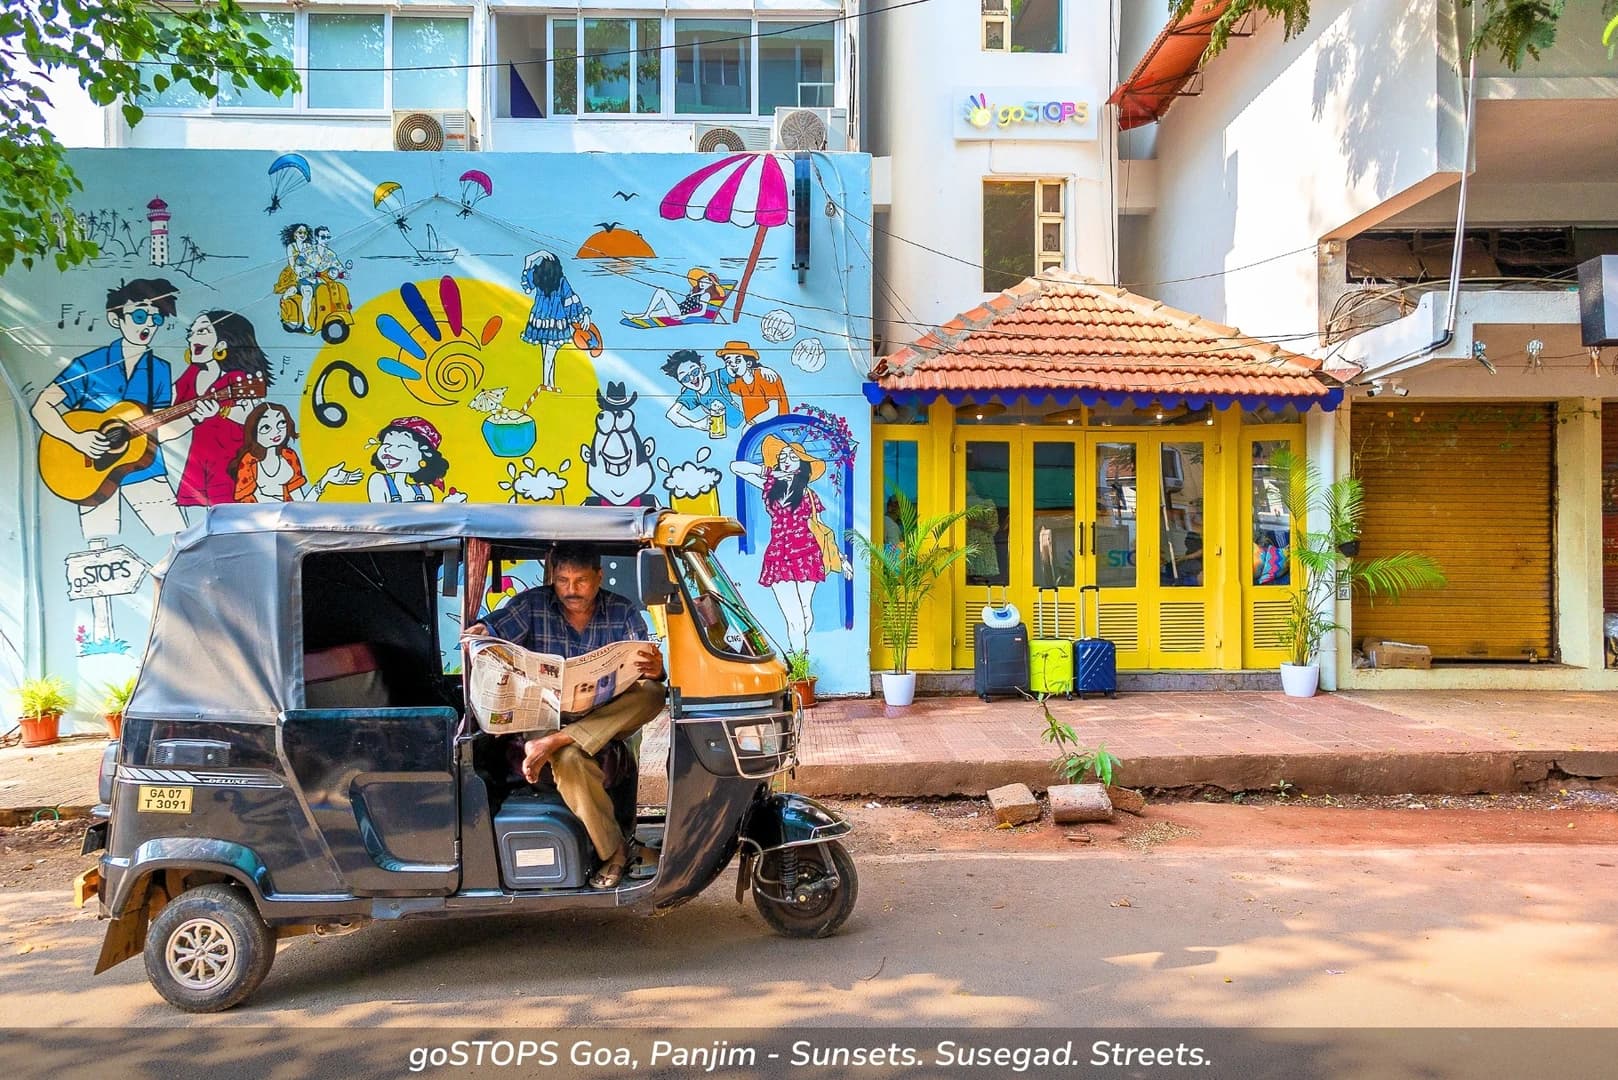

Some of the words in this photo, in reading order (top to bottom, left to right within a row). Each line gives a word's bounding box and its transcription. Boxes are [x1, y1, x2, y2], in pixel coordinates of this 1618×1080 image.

[998, 101, 1088, 127] goSTOPS
[74, 560, 131, 592] goSTOPS
[150, 789, 165, 798] GA
[168, 789, 182, 798] 07
[145, 799, 152, 808] T
[156, 800, 186, 809] 3091
